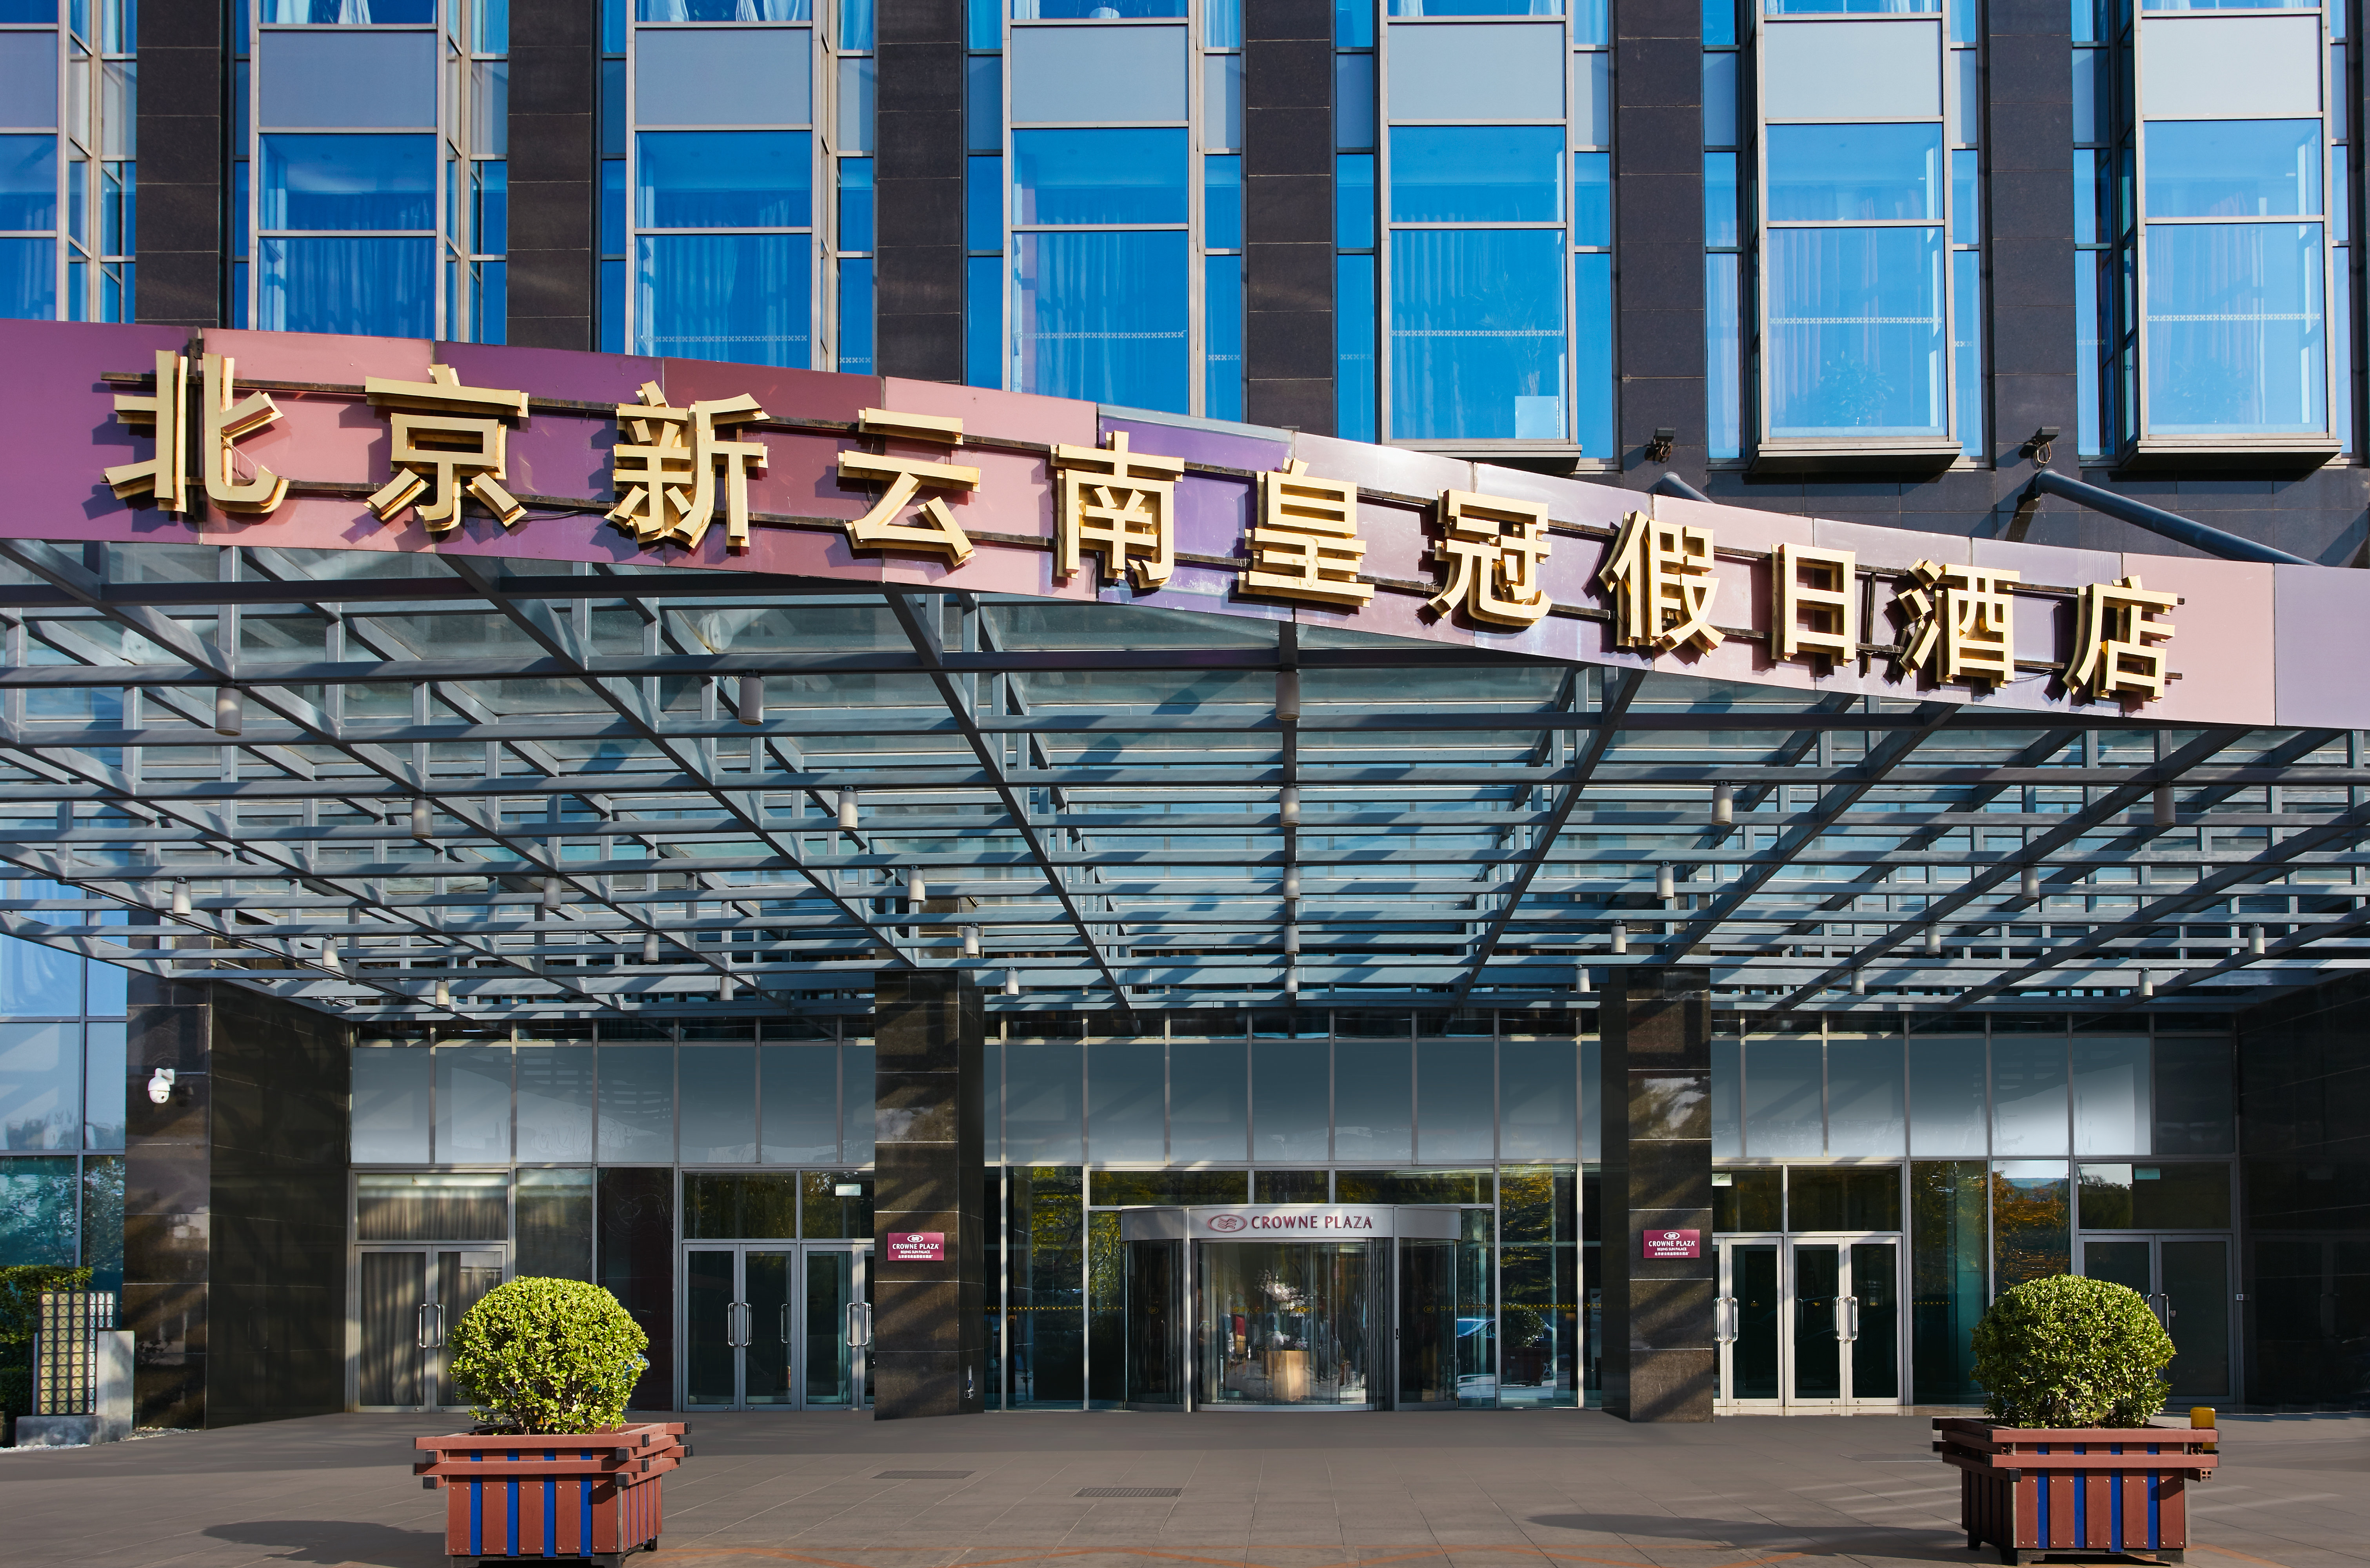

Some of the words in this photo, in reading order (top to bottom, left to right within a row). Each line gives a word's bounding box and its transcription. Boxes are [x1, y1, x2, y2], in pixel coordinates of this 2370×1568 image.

[104, 350, 2179, 703] 北京新云南皇冠假日酒店
[1252, 1216, 1317, 1229] CROWNE
[1325, 1216, 1372, 1229] PLAZA
